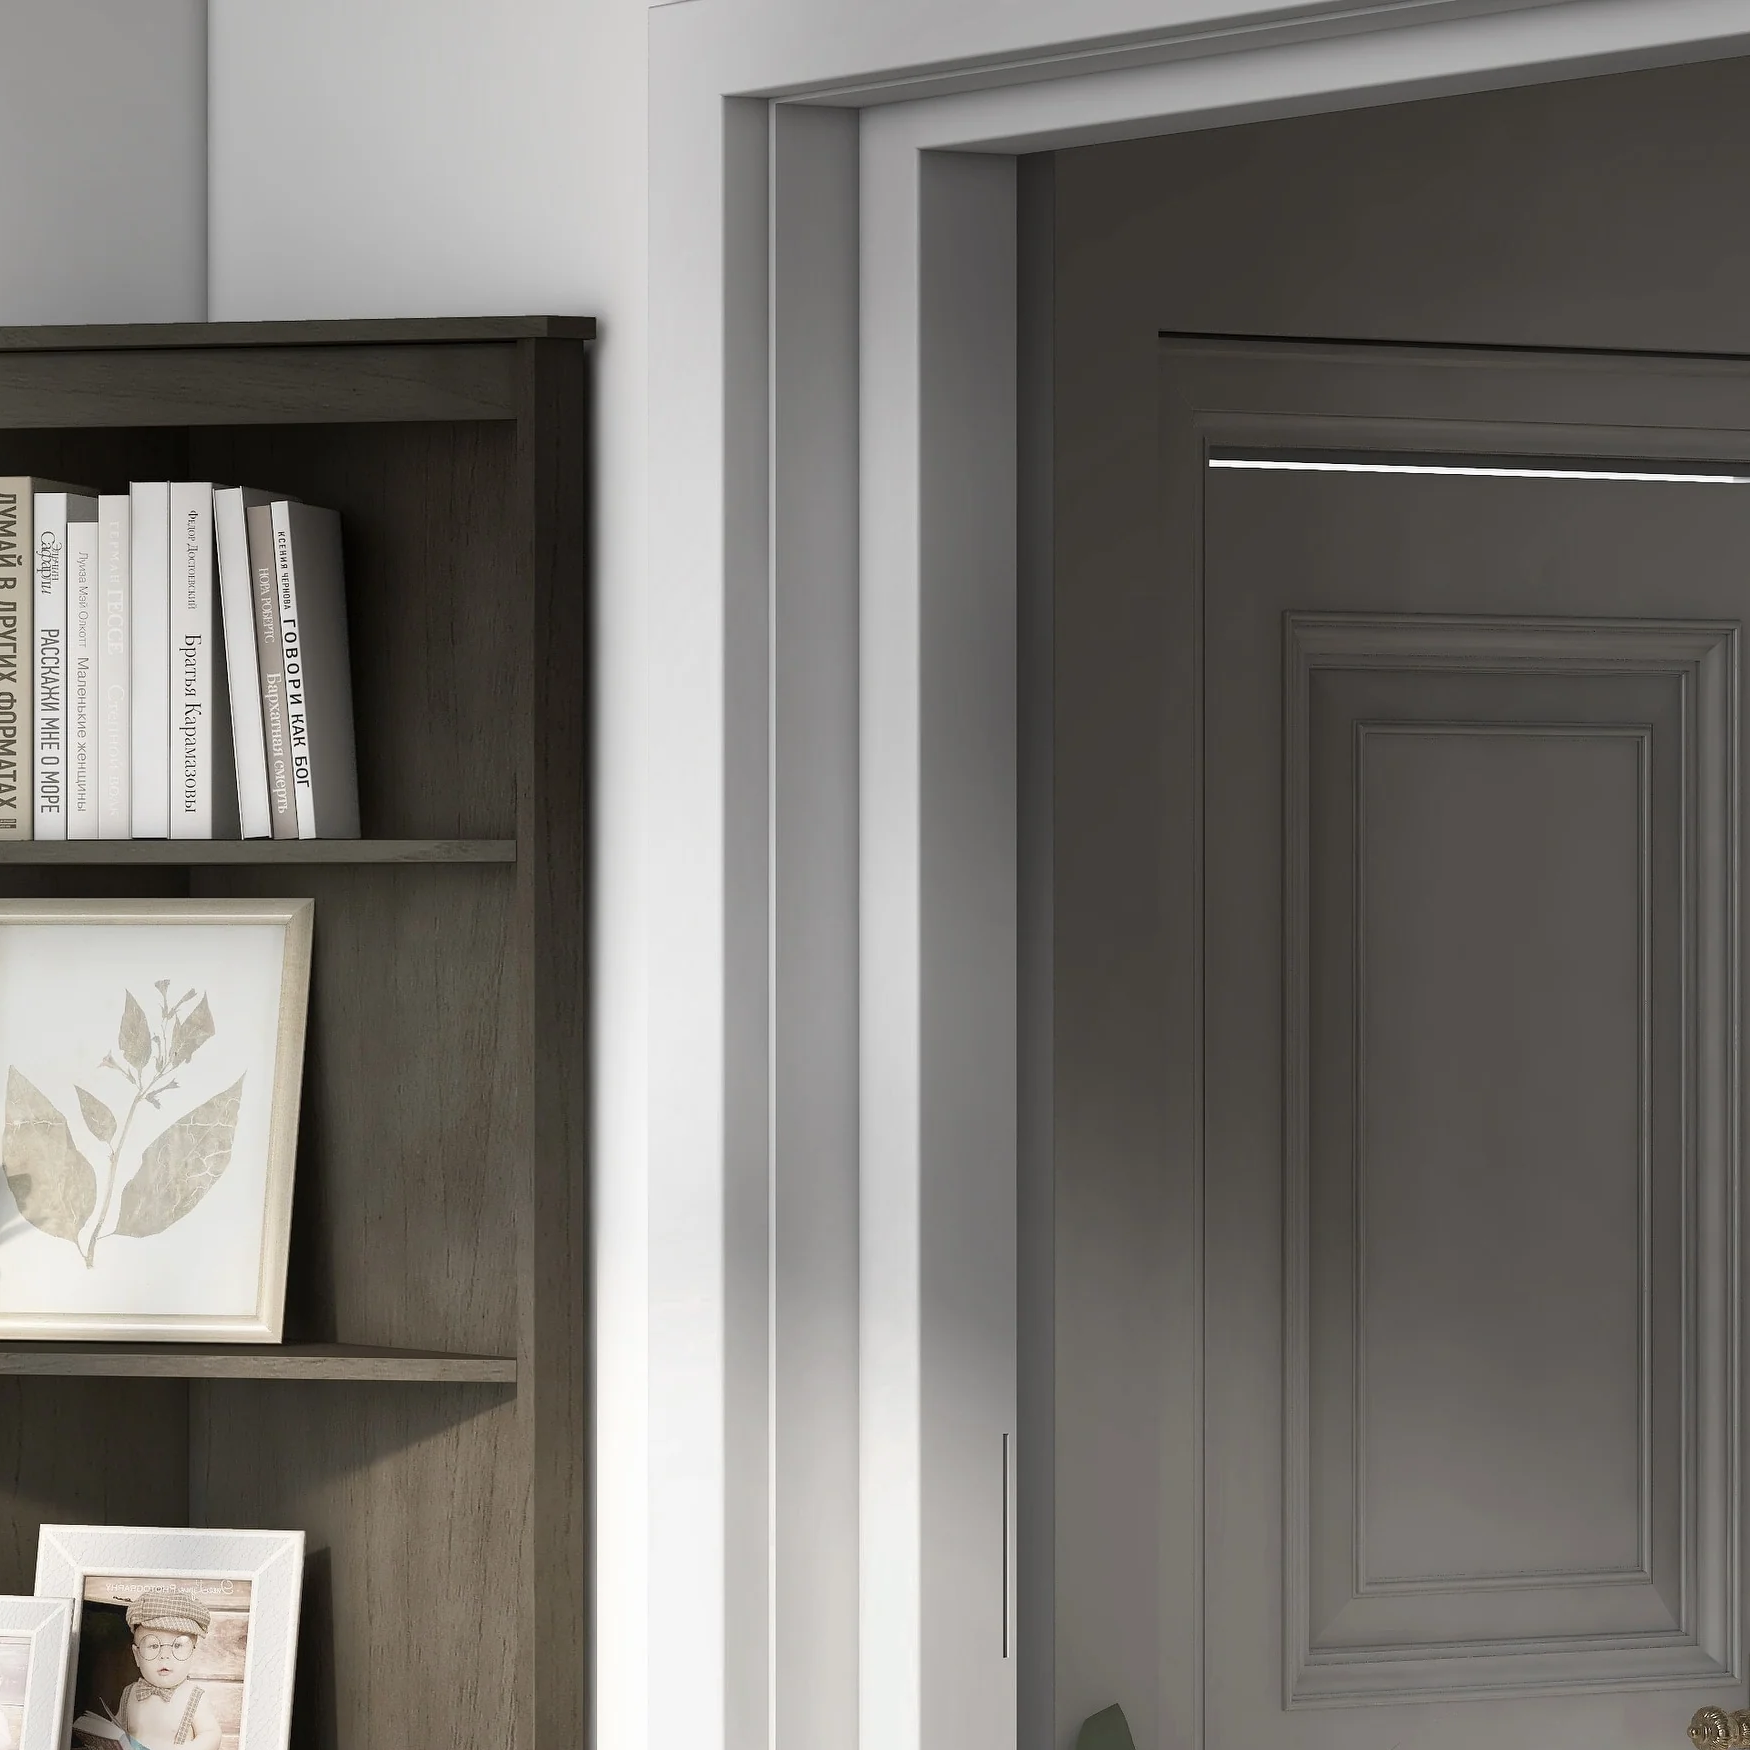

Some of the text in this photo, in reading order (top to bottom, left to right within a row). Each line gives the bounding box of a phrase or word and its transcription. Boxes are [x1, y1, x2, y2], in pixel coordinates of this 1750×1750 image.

[36, 531, 57, 595] Сафарли
[77, 552, 89, 648] Луиза Мэй Олкотт
[107, 521, 124, 656] ГЕРМАН ГЕССЕ
[258, 567, 275, 644] НОРА РОБЕРТС
[277, 531, 292, 610] КСЕНИЯ ЧЕРНОВА
[40, 628, 59, 813] РАССКАЖИ МНЕ О МОРЕ
[75, 657, 90, 812] Маленькие женщины
[180, 634, 202, 813] Братья Карамазовы
[265, 672, 290, 814] Бархатная смерть
[283, 618, 310, 788] ГОВОРИ КАК БОГ
